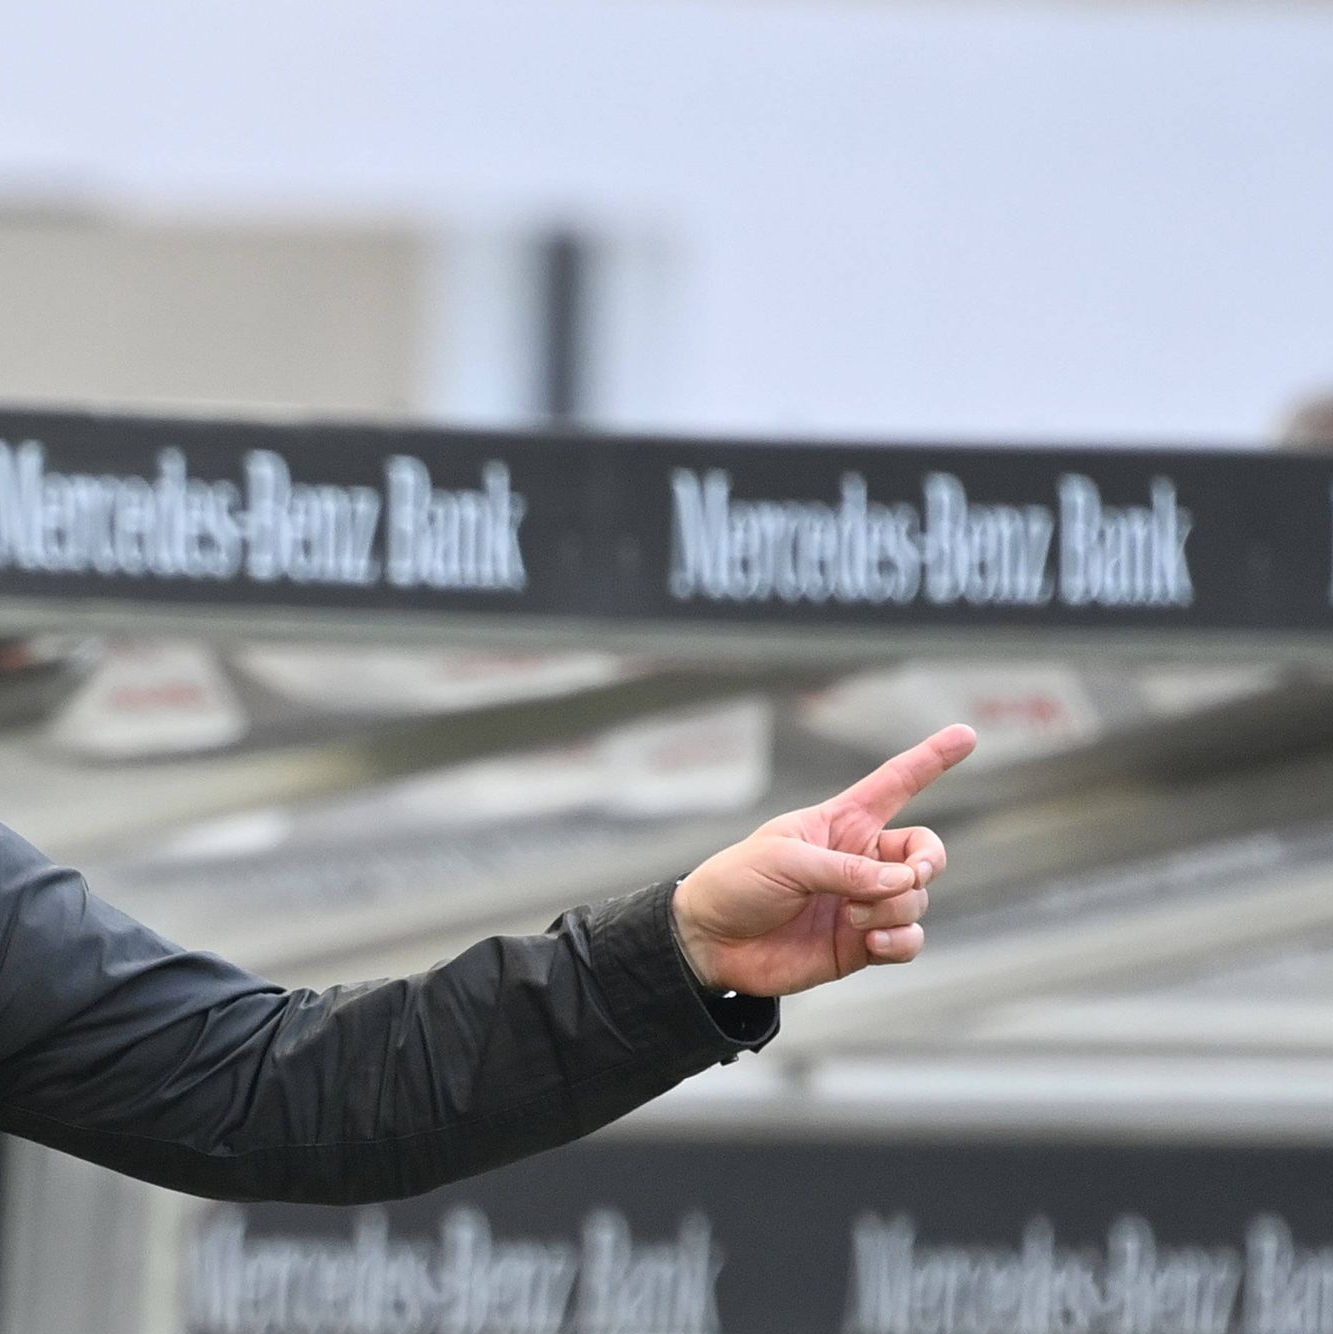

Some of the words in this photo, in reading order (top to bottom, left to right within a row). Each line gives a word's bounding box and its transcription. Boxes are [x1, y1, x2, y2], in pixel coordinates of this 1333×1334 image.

[384, 453, 525, 590] Bank
[670, 468, 1055, 604] Mercedes-Benz
[1056, 472, 1193, 607] Bank
